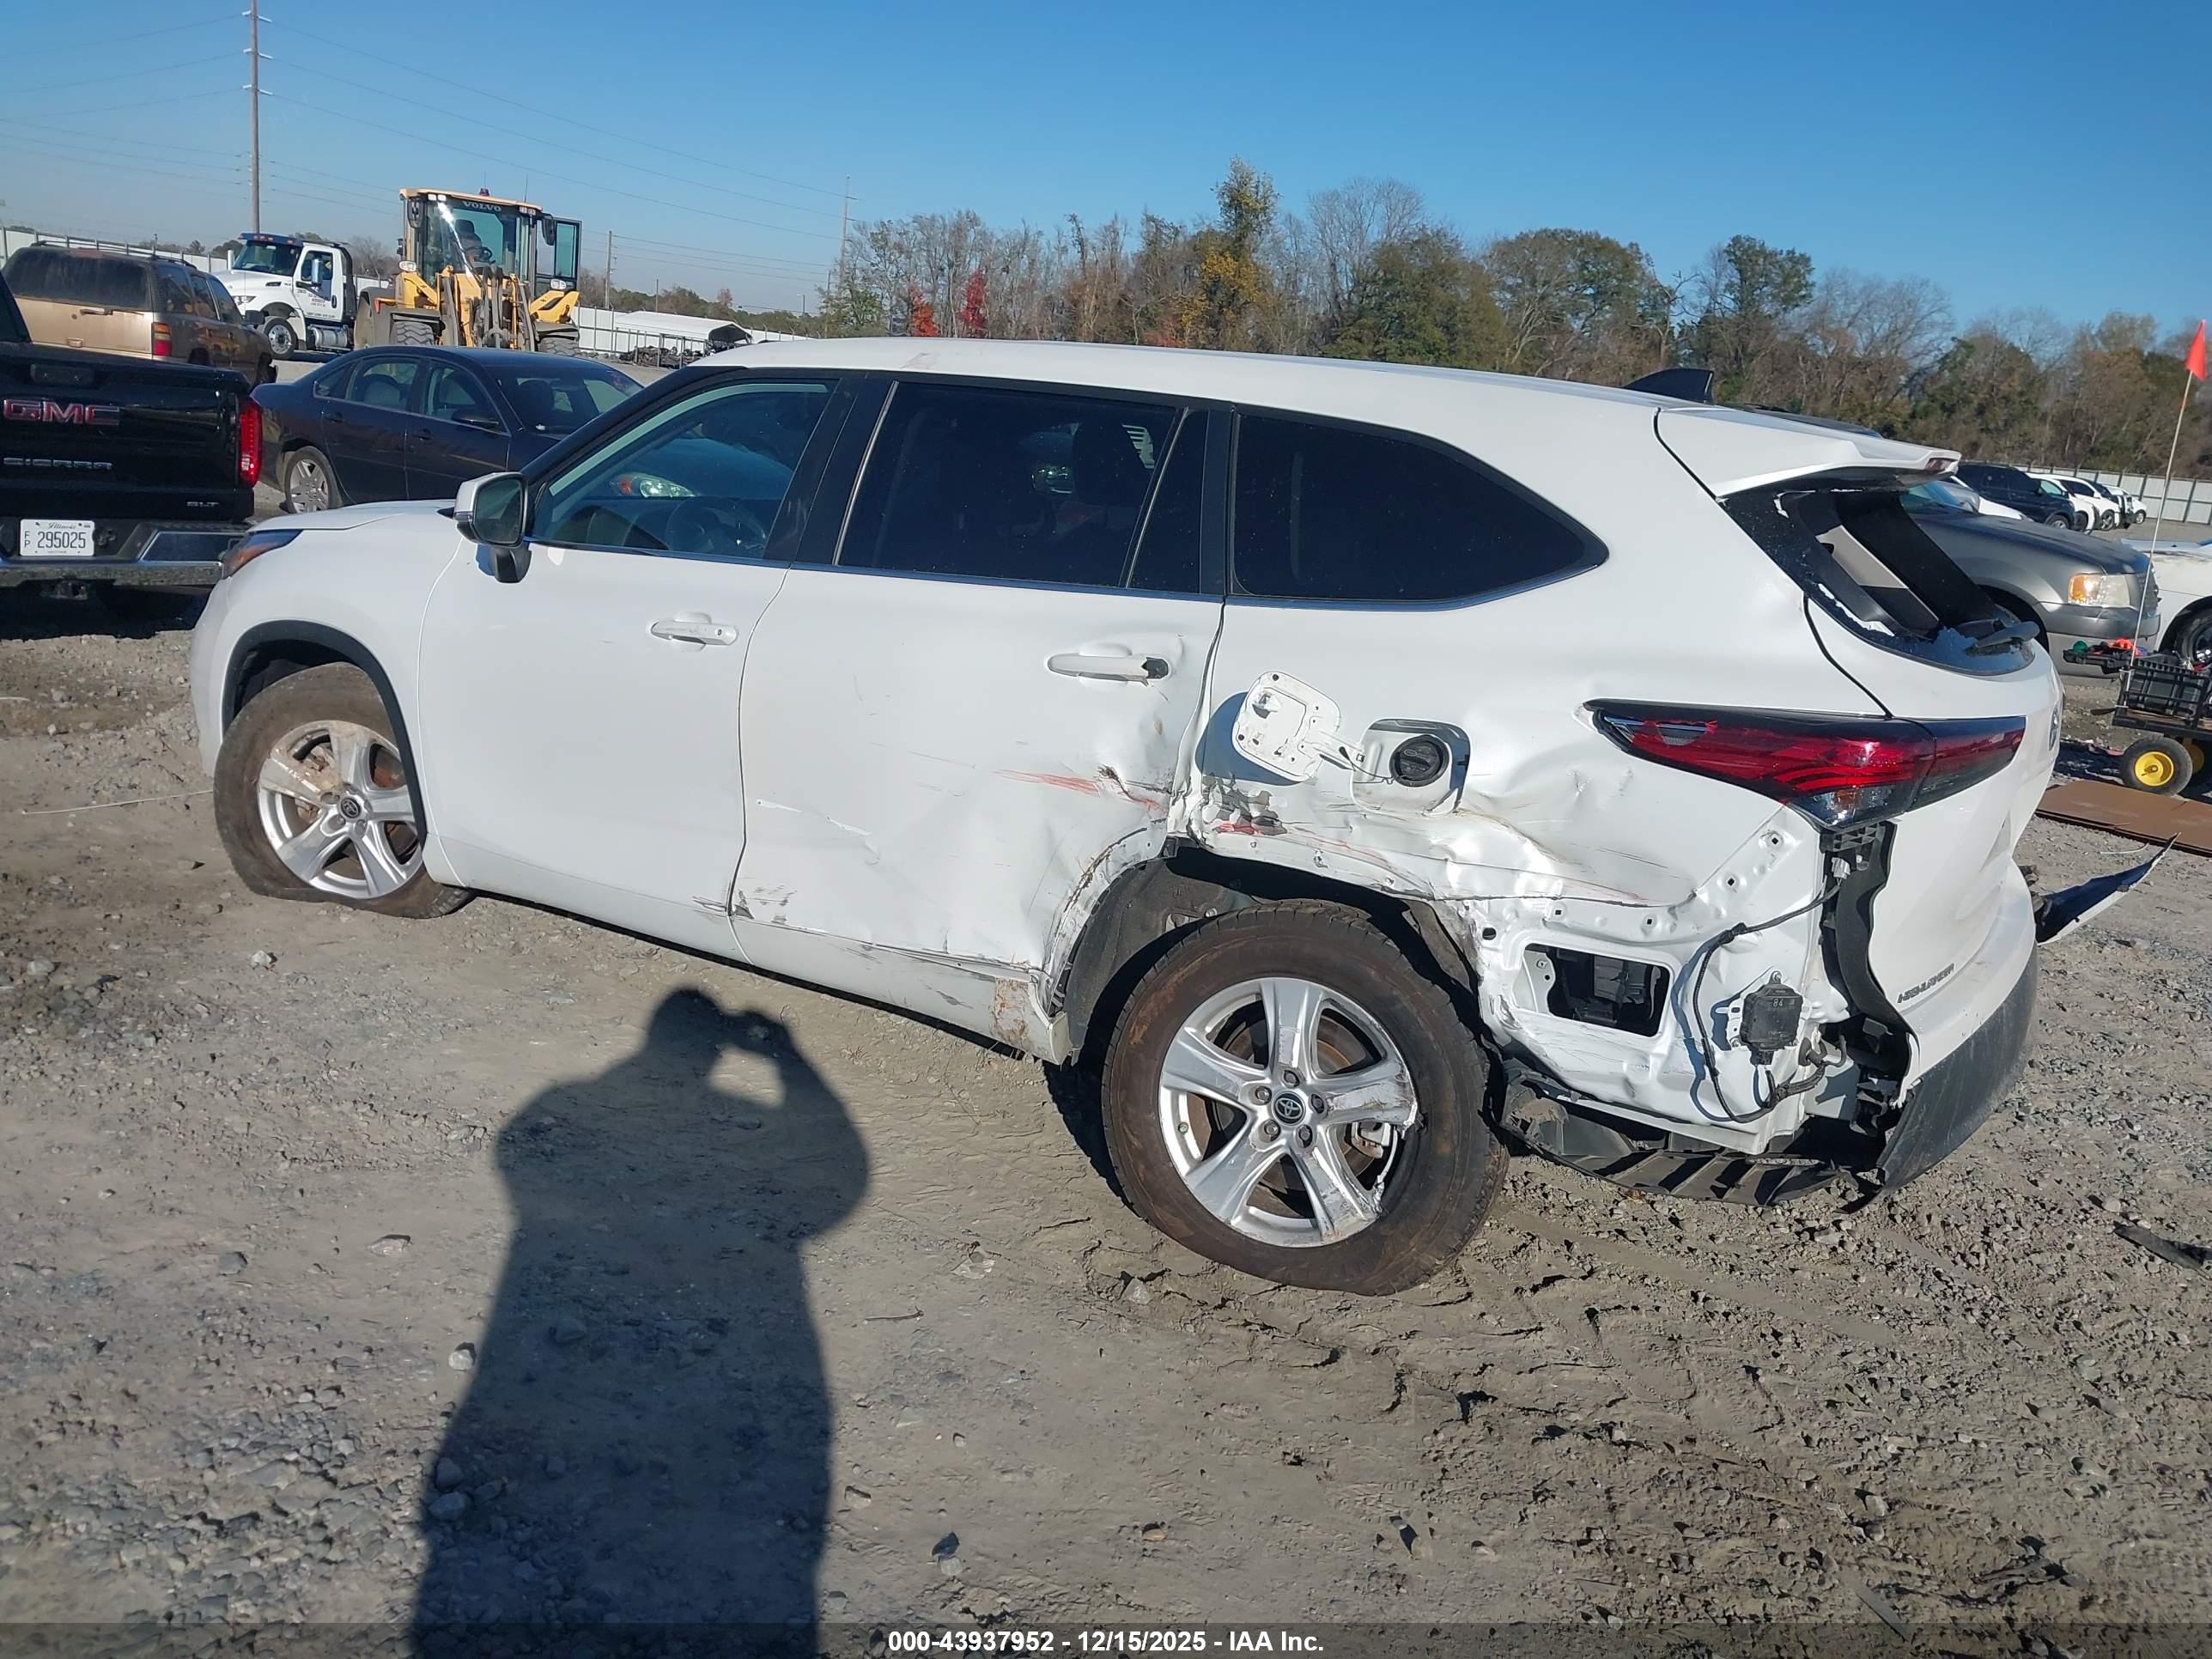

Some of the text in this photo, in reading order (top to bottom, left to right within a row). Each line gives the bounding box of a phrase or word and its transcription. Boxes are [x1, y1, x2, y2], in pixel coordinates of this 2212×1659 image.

[462, 200, 502, 212] VOLVO
[3, 398, 120, 426] GMC
[3, 457, 112, 470] SIERRA
[37, 531, 87, 549] 295025
